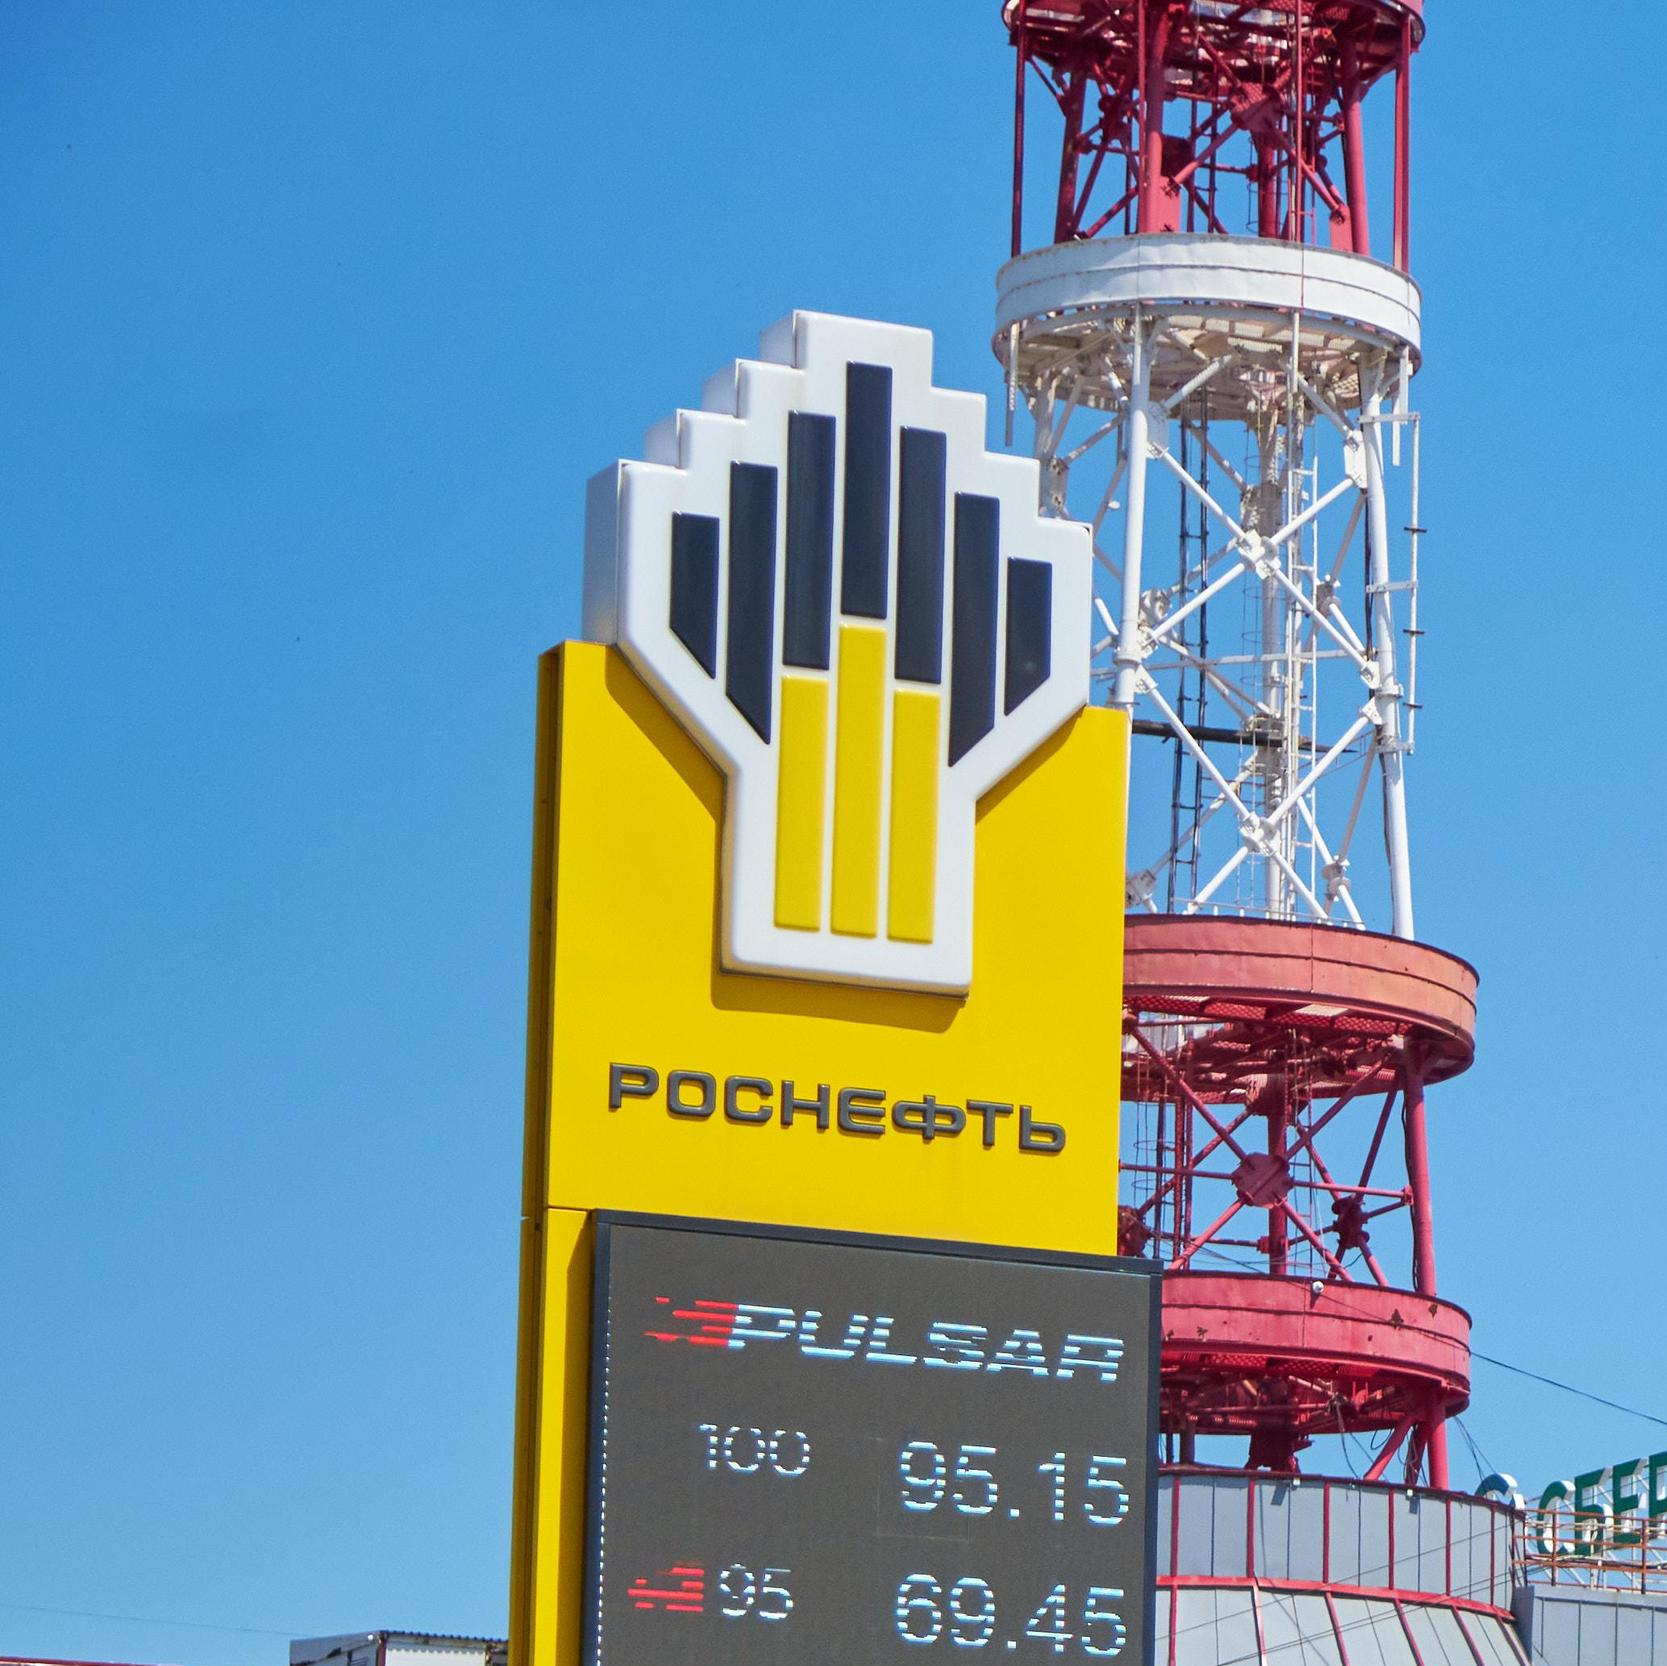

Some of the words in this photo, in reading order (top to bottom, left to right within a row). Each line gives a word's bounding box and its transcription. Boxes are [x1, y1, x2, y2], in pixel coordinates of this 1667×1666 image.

[609, 1062, 1066, 1152] РОСНЕФТЬ
[728, 1304, 1124, 1381] PULSAR
[699, 1424, 810, 1475] 100
[900, 1441, 1129, 1525] 95.15
[718, 1564, 793, 1619] 95
[896, 1574, 1127, 1656] 69.45
